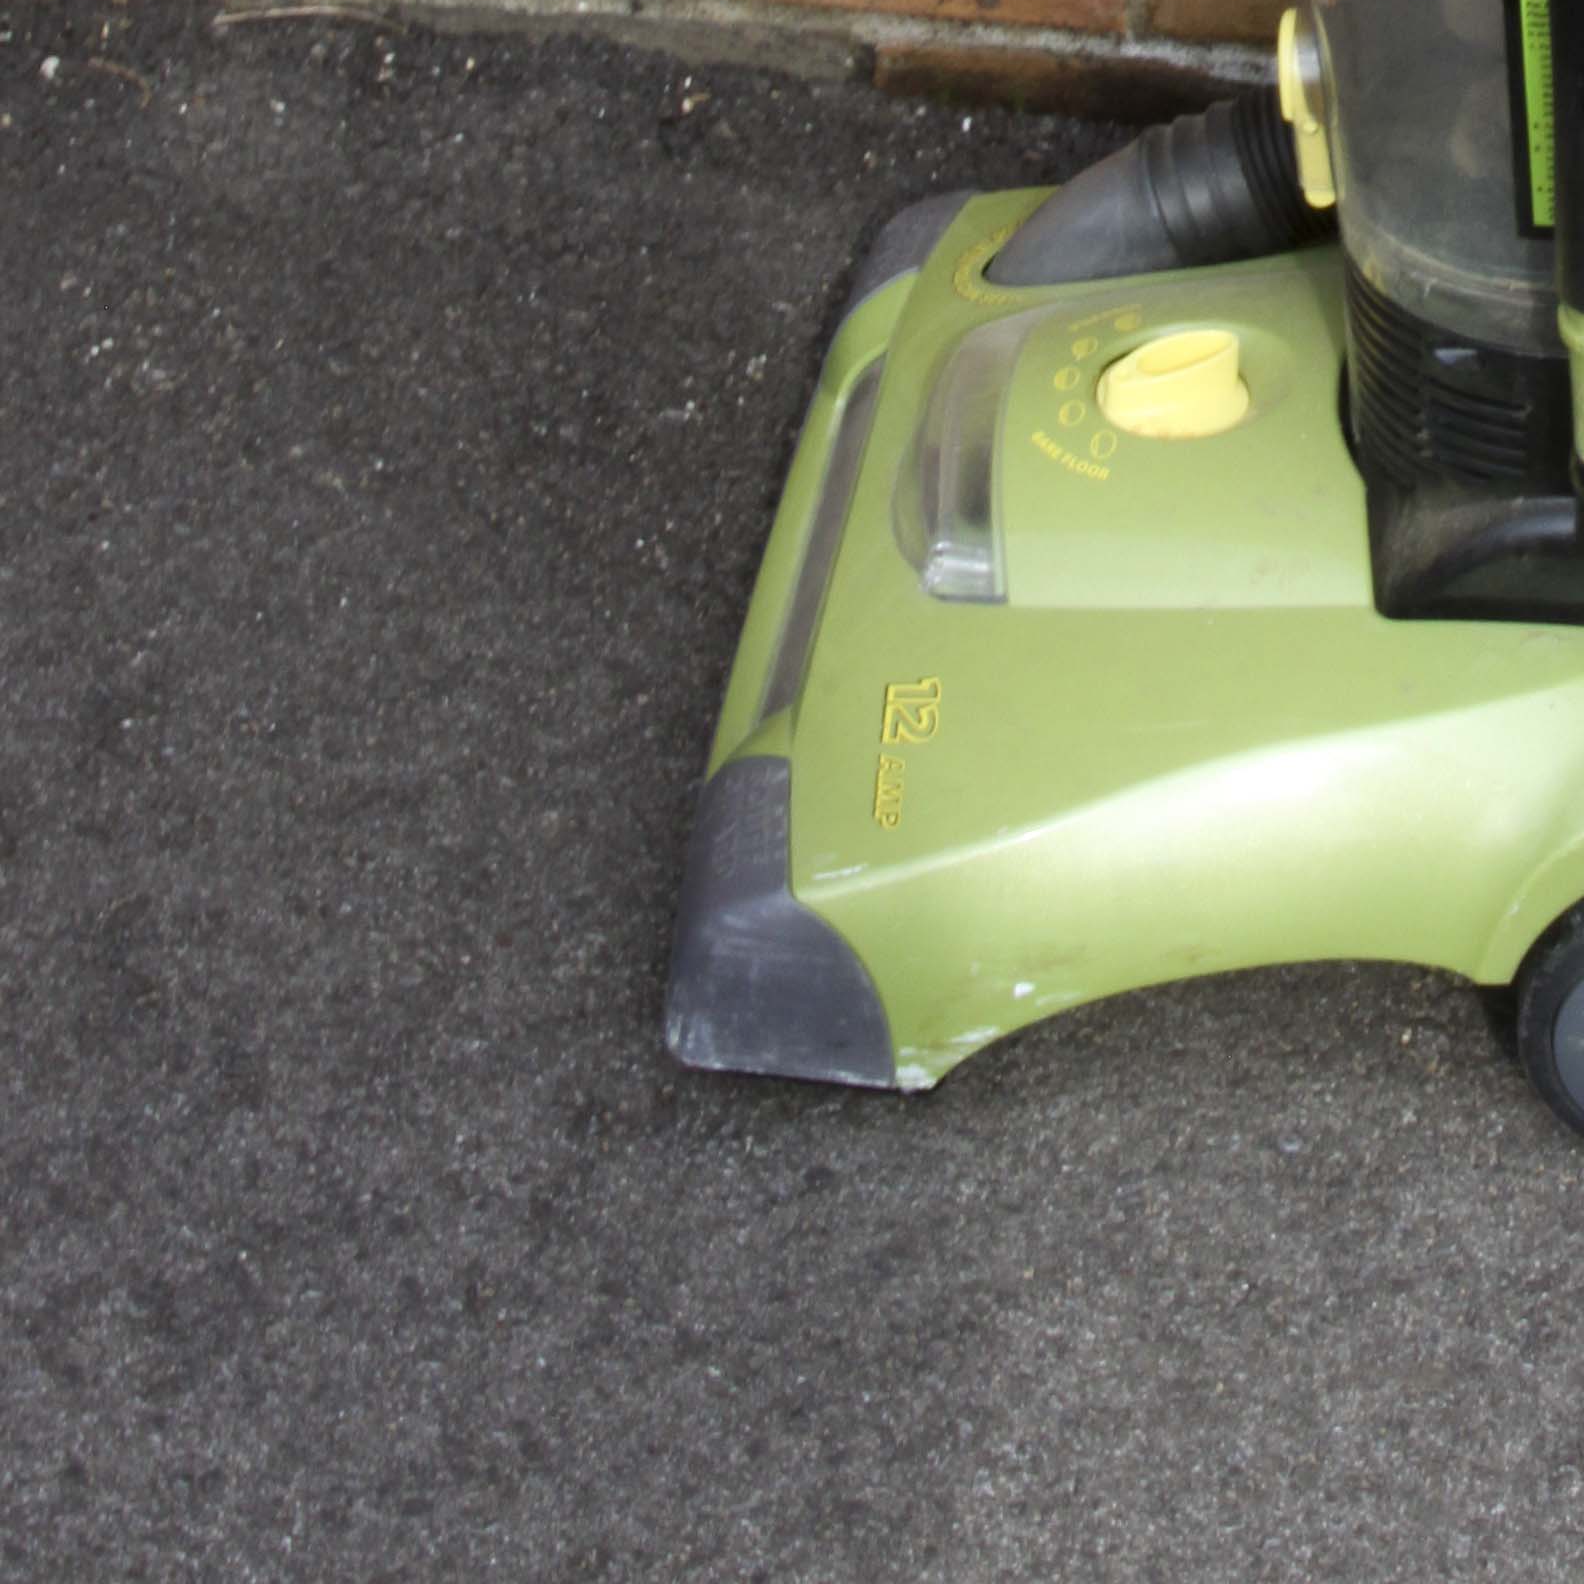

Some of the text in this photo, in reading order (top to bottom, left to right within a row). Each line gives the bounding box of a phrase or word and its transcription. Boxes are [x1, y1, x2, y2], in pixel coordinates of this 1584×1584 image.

[1061, 453, 1111, 481] FLOOR
[874, 676, 942, 831] 12 AMP
